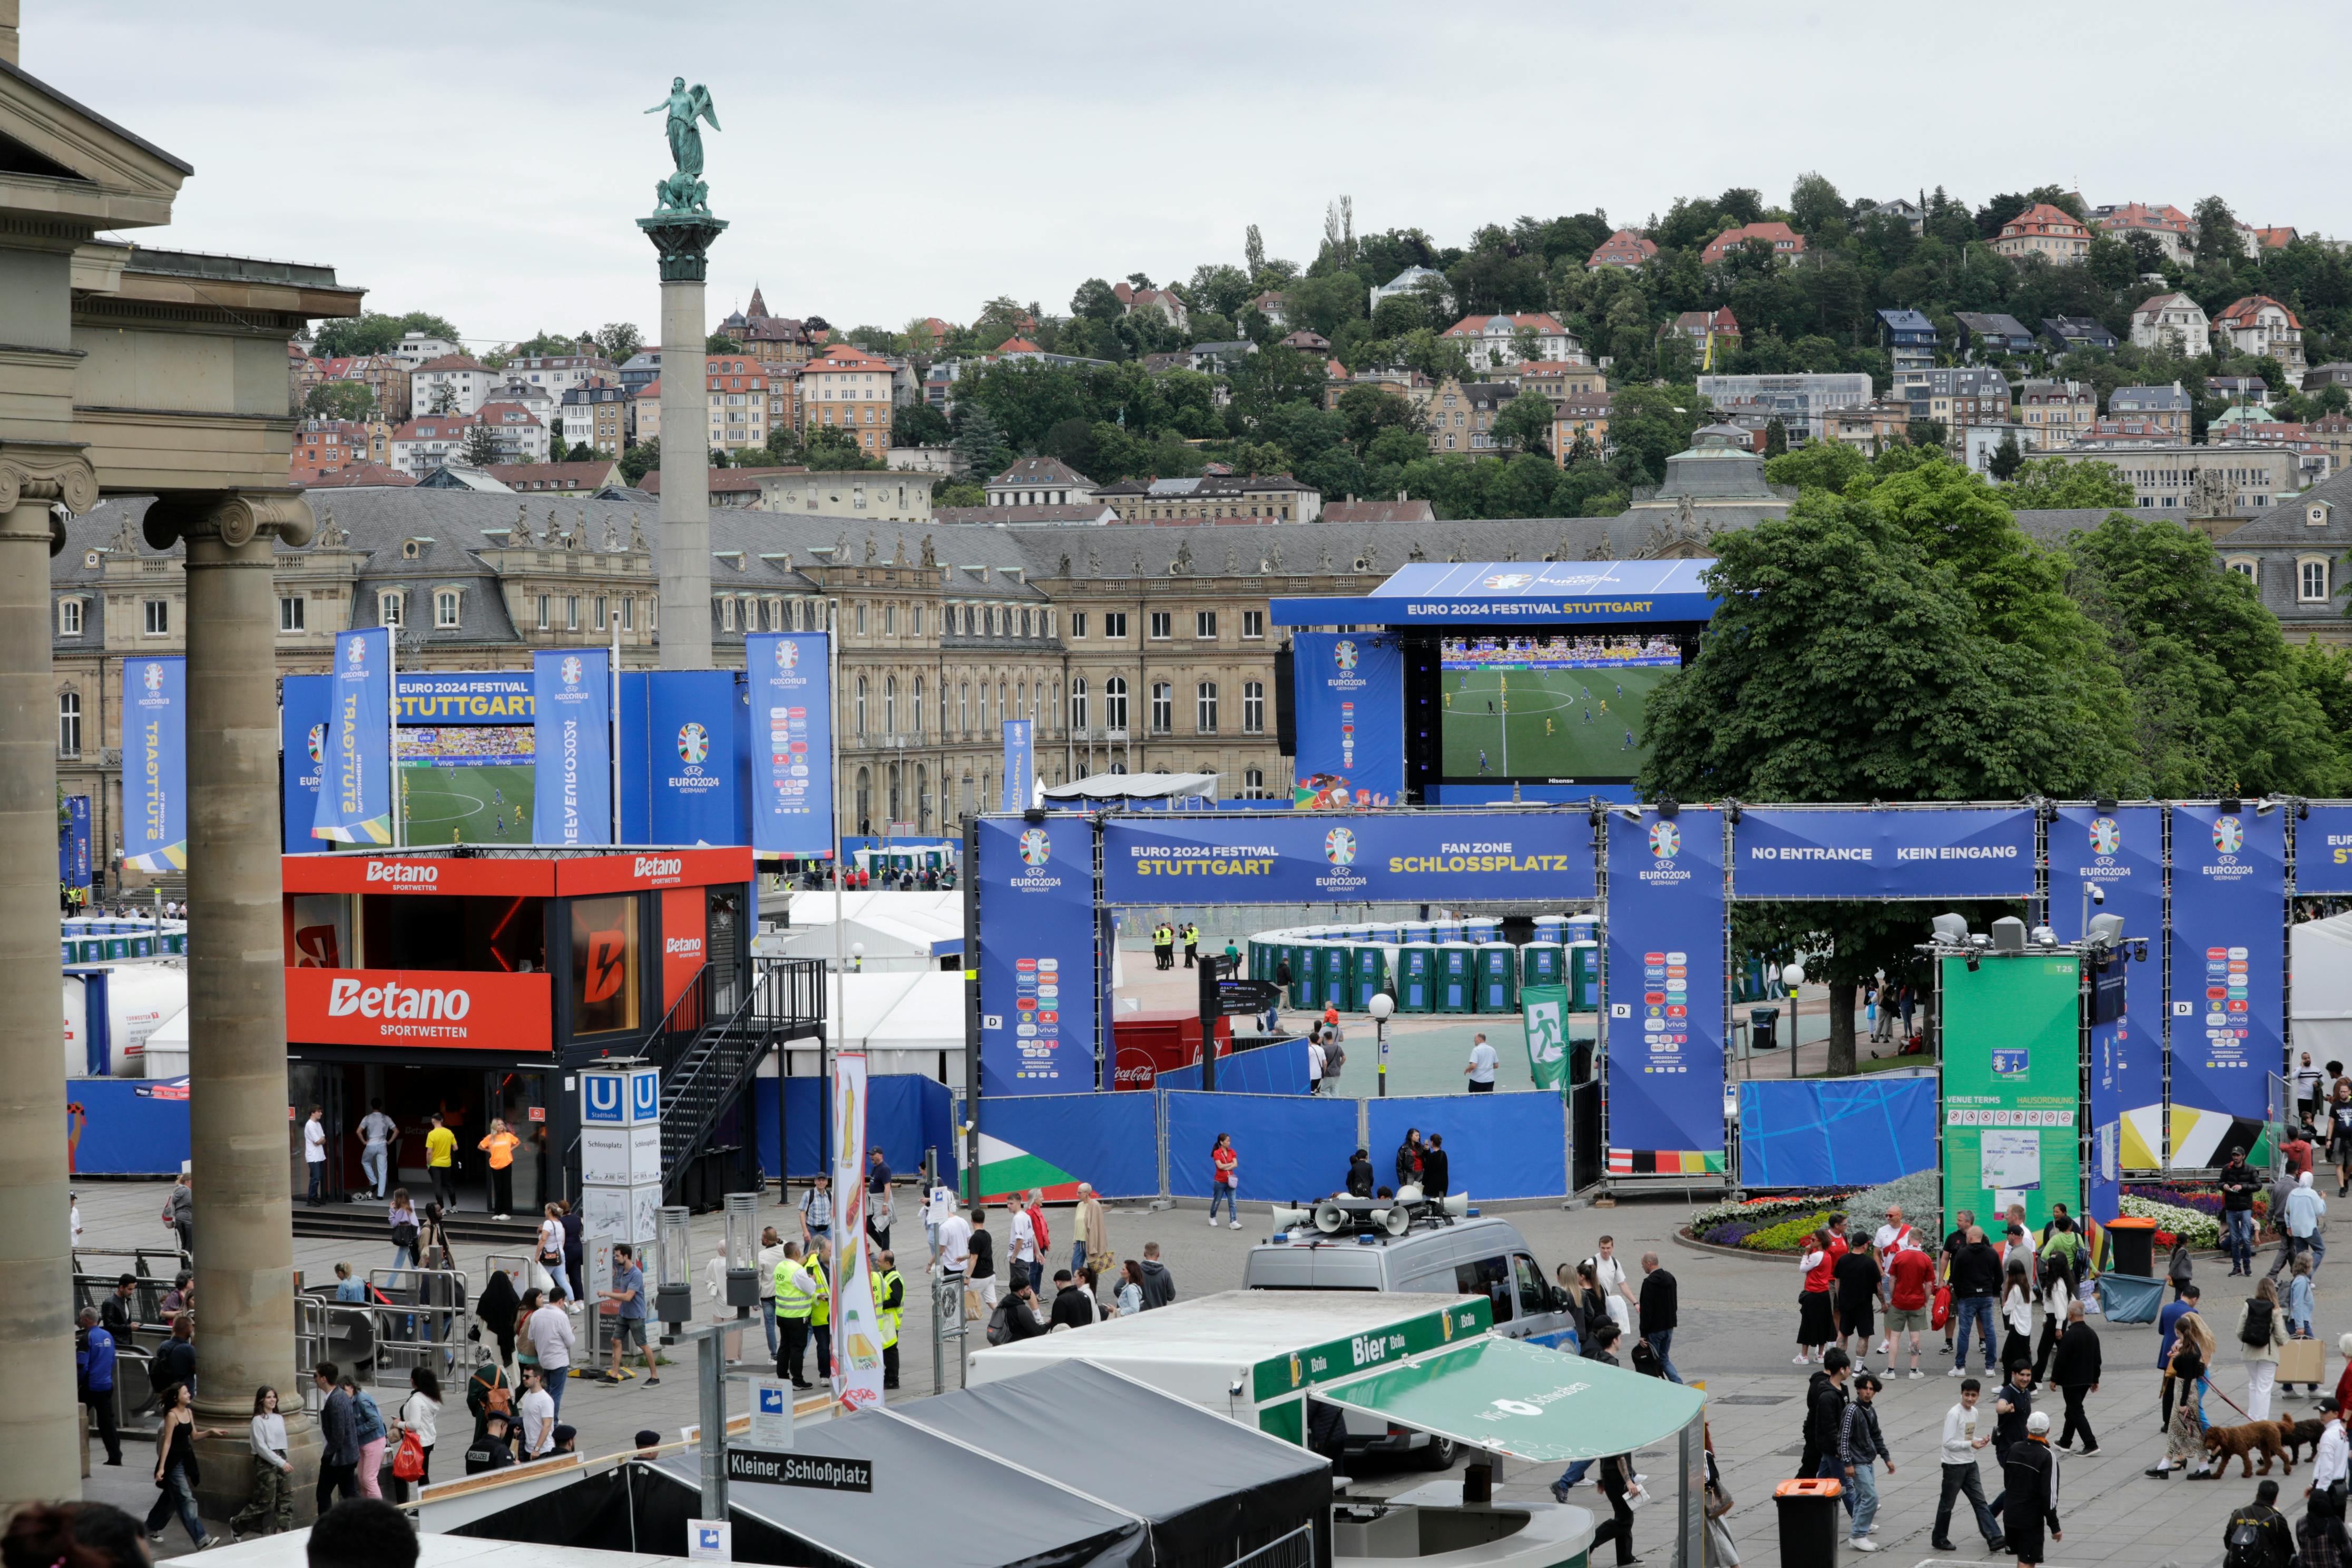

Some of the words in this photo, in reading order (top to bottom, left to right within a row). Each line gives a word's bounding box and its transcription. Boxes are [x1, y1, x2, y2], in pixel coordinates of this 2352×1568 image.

[1408, 604, 1447, 615] EURO
[1451, 604, 1489, 615] 2024
[1492, 603, 1561, 614] FESTIVAL
[1563, 601, 1652, 614] STUTTGART
[399, 683, 433, 693] EURO
[435, 683, 468, 693] 2024
[469, 682, 528, 692] FESTIVAL
[683, 766, 704, 776] UEFA
[669, 778, 719, 787] EURO2024
[1131, 847, 1171, 857] EURO
[1173, 847, 1210, 857] 2024
[1212, 846, 1278, 856] FESTIVAL
[1442, 844, 1470, 853] FAN
[1473, 843, 1512, 853] ZONE
[1897, 848, 1937, 860] KEIN
[1940, 846, 2017, 859] EINGANG
[1751, 848, 1776, 859] NO
[1780, 848, 1872, 860] ENTRANCE
[1389, 855, 1568, 873] SCHLOSSPLATZ
[1655, 860, 1675, 870] UEFA
[2095, 857, 2115, 866] UEFA
[2218, 856, 2238, 865] UEFA
[366, 861, 438, 883] Betano
[634, 857, 681, 877] Betano
[1137, 859, 1274, 875] STUTTGART
[1331, 867, 1351, 876] UEFA
[2080, 867, 2131, 876] EURO2024
[2202, 866, 2253, 875] EURO2024
[1024, 868, 1046, 877] UEFA
[1640, 870, 1691, 880] EURO2024
[651, 876, 681, 885] SPORTWETTEN
[1011, 878, 1061, 887] EURO2024
[1316, 877, 1367, 886] EURO2024
[666, 937, 701, 954] Betano
[328, 978, 470, 1021] Betano
[1617, 1006, 1625, 1015] D
[989, 1017, 997, 1026] D
[380, 1024, 467, 1038] SPORTWETTEN
[591, 1079, 616, 1110] U
[636, 1077, 653, 1109] U
[635, 1140, 657, 1148] Schlossplatz
[1311, 1356, 1327, 1373] Bräu
[1351, 1335, 1386, 1366] Bier
[1390, 1334, 1405, 1350] Bräu
[1461, 1313, 1475, 1328] Bräu
[1473, 1410, 1511, 1422] Wir
[1524, 1381, 1592, 1406] Schwaben
[731, 1455, 780, 1476] Kleiner
[787, 1459, 868, 1486] Schloßplatz
